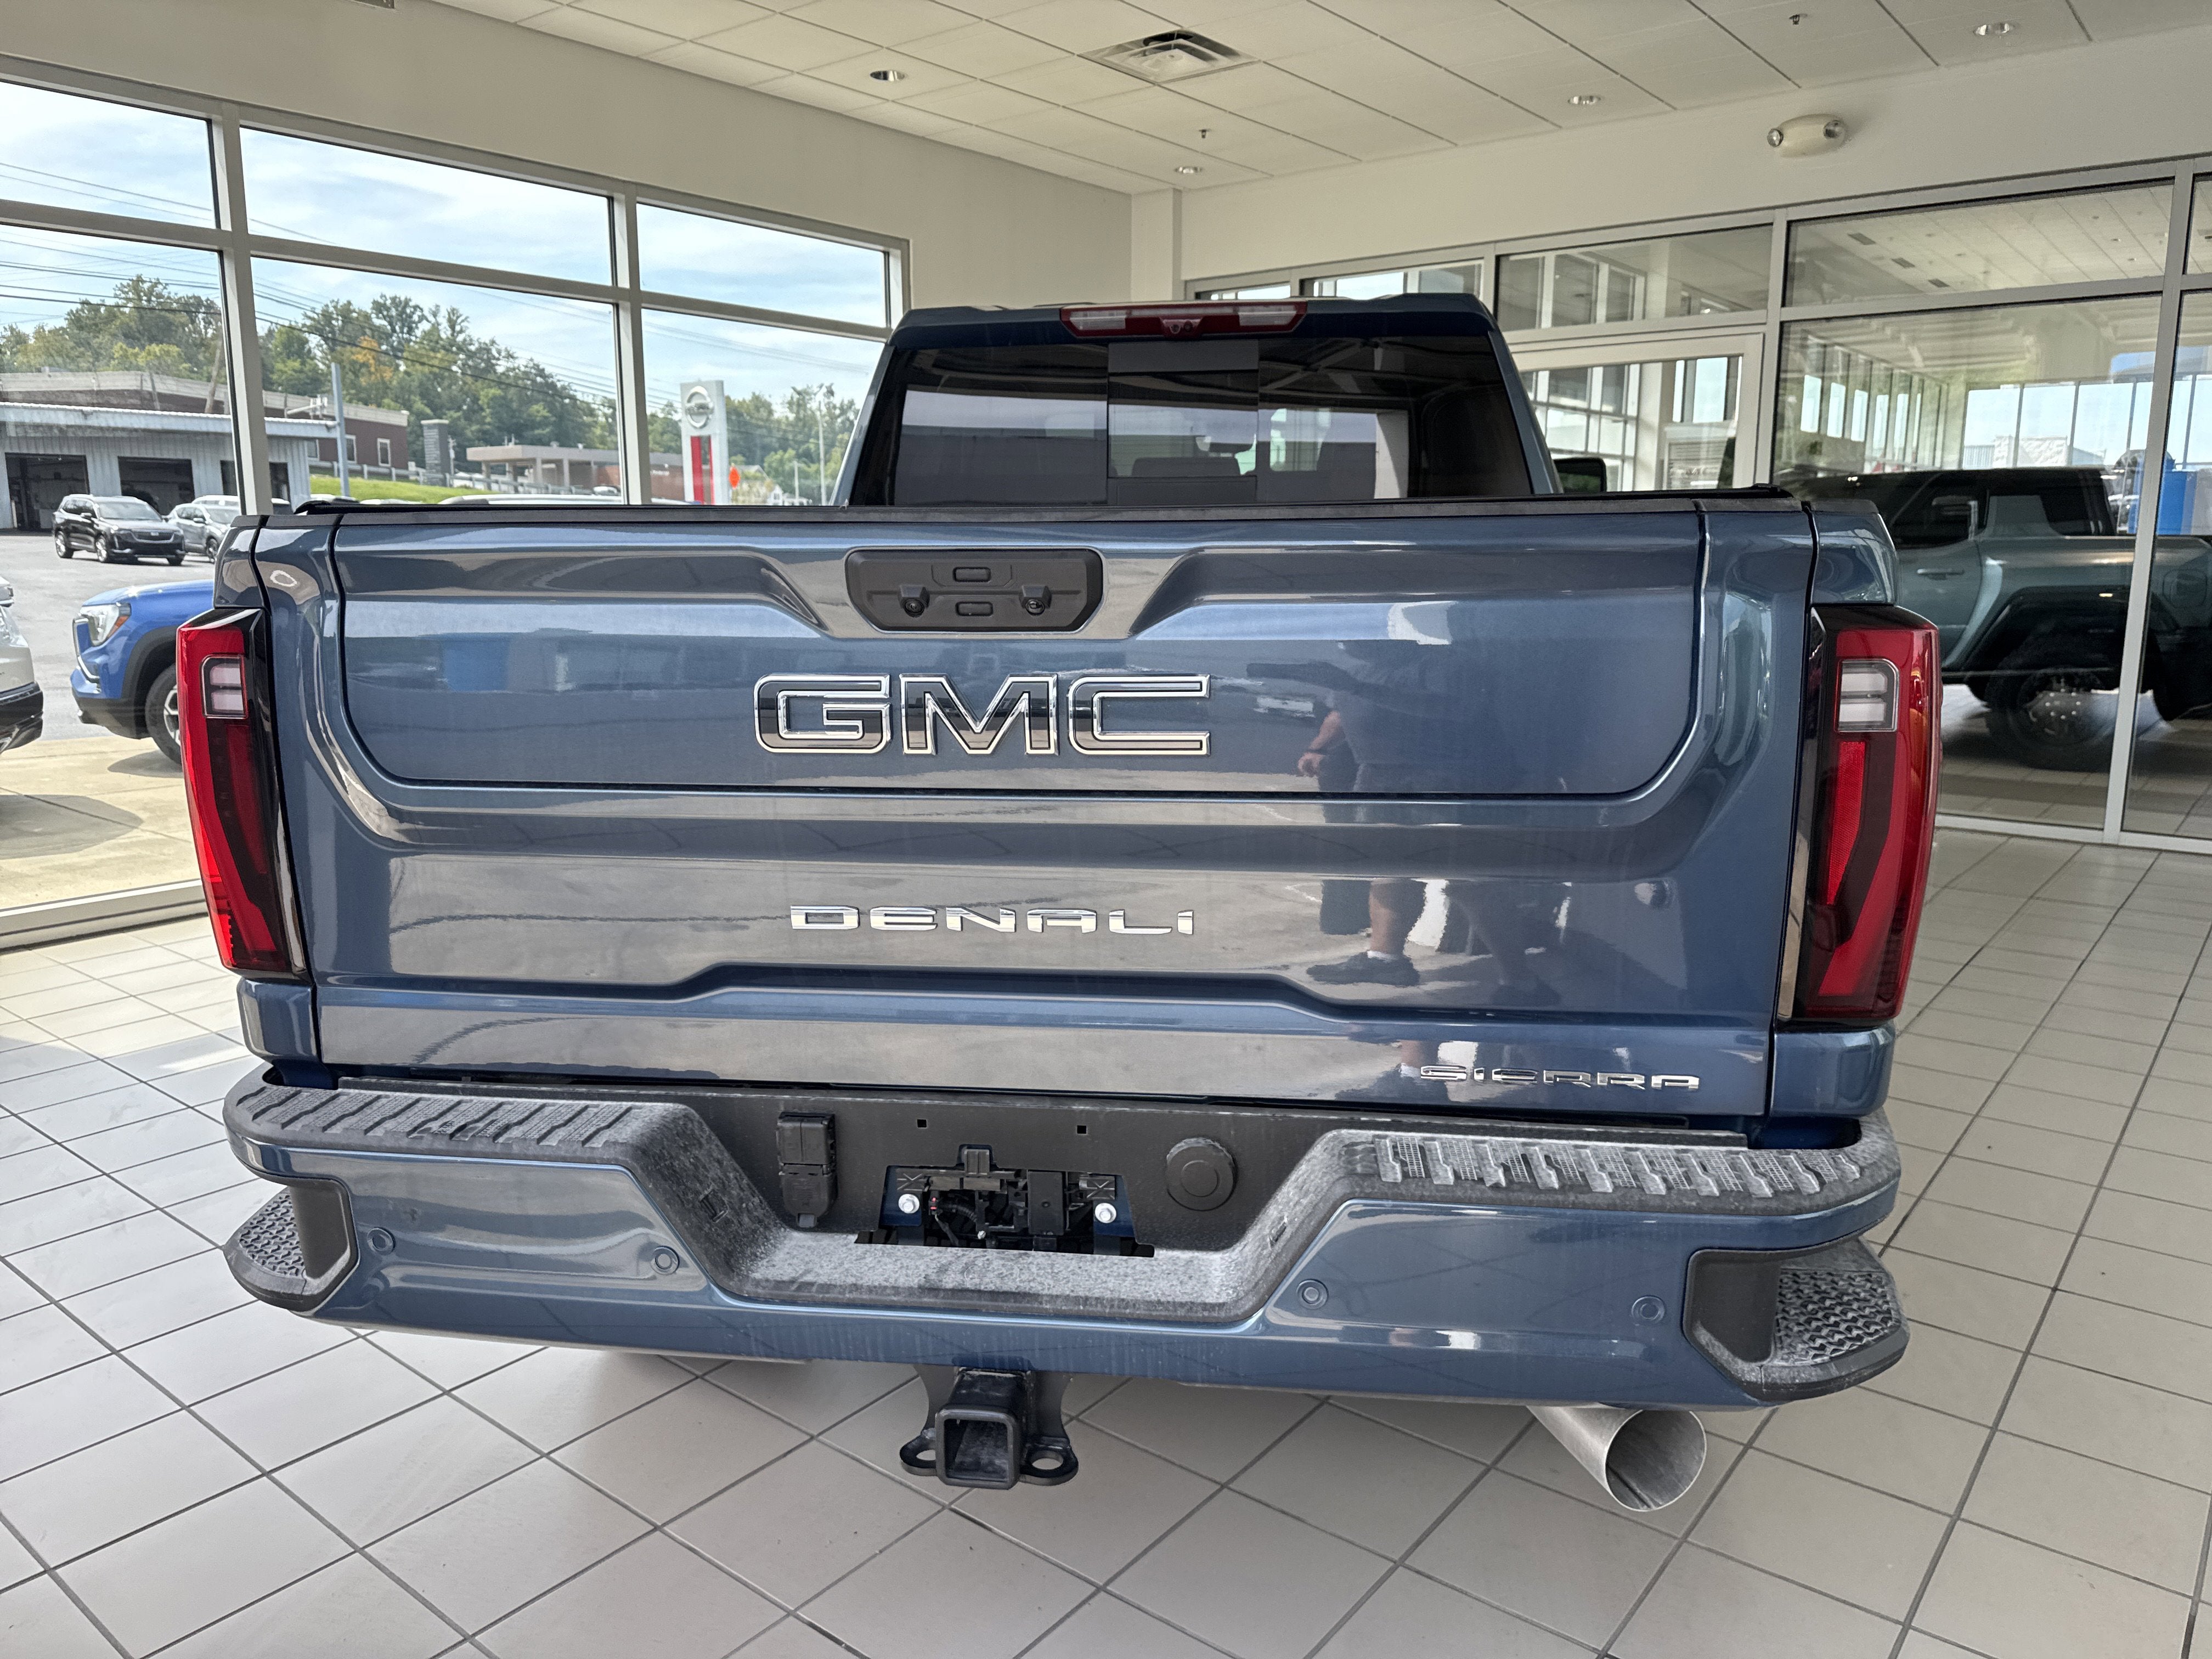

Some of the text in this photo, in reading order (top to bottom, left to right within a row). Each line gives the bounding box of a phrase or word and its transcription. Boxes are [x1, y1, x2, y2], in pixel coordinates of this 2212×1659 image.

[754, 673, 1211, 755] GMC
[790, 905, 1194, 935] DENALI
[1420, 1064, 1700, 1090] SIERRA
